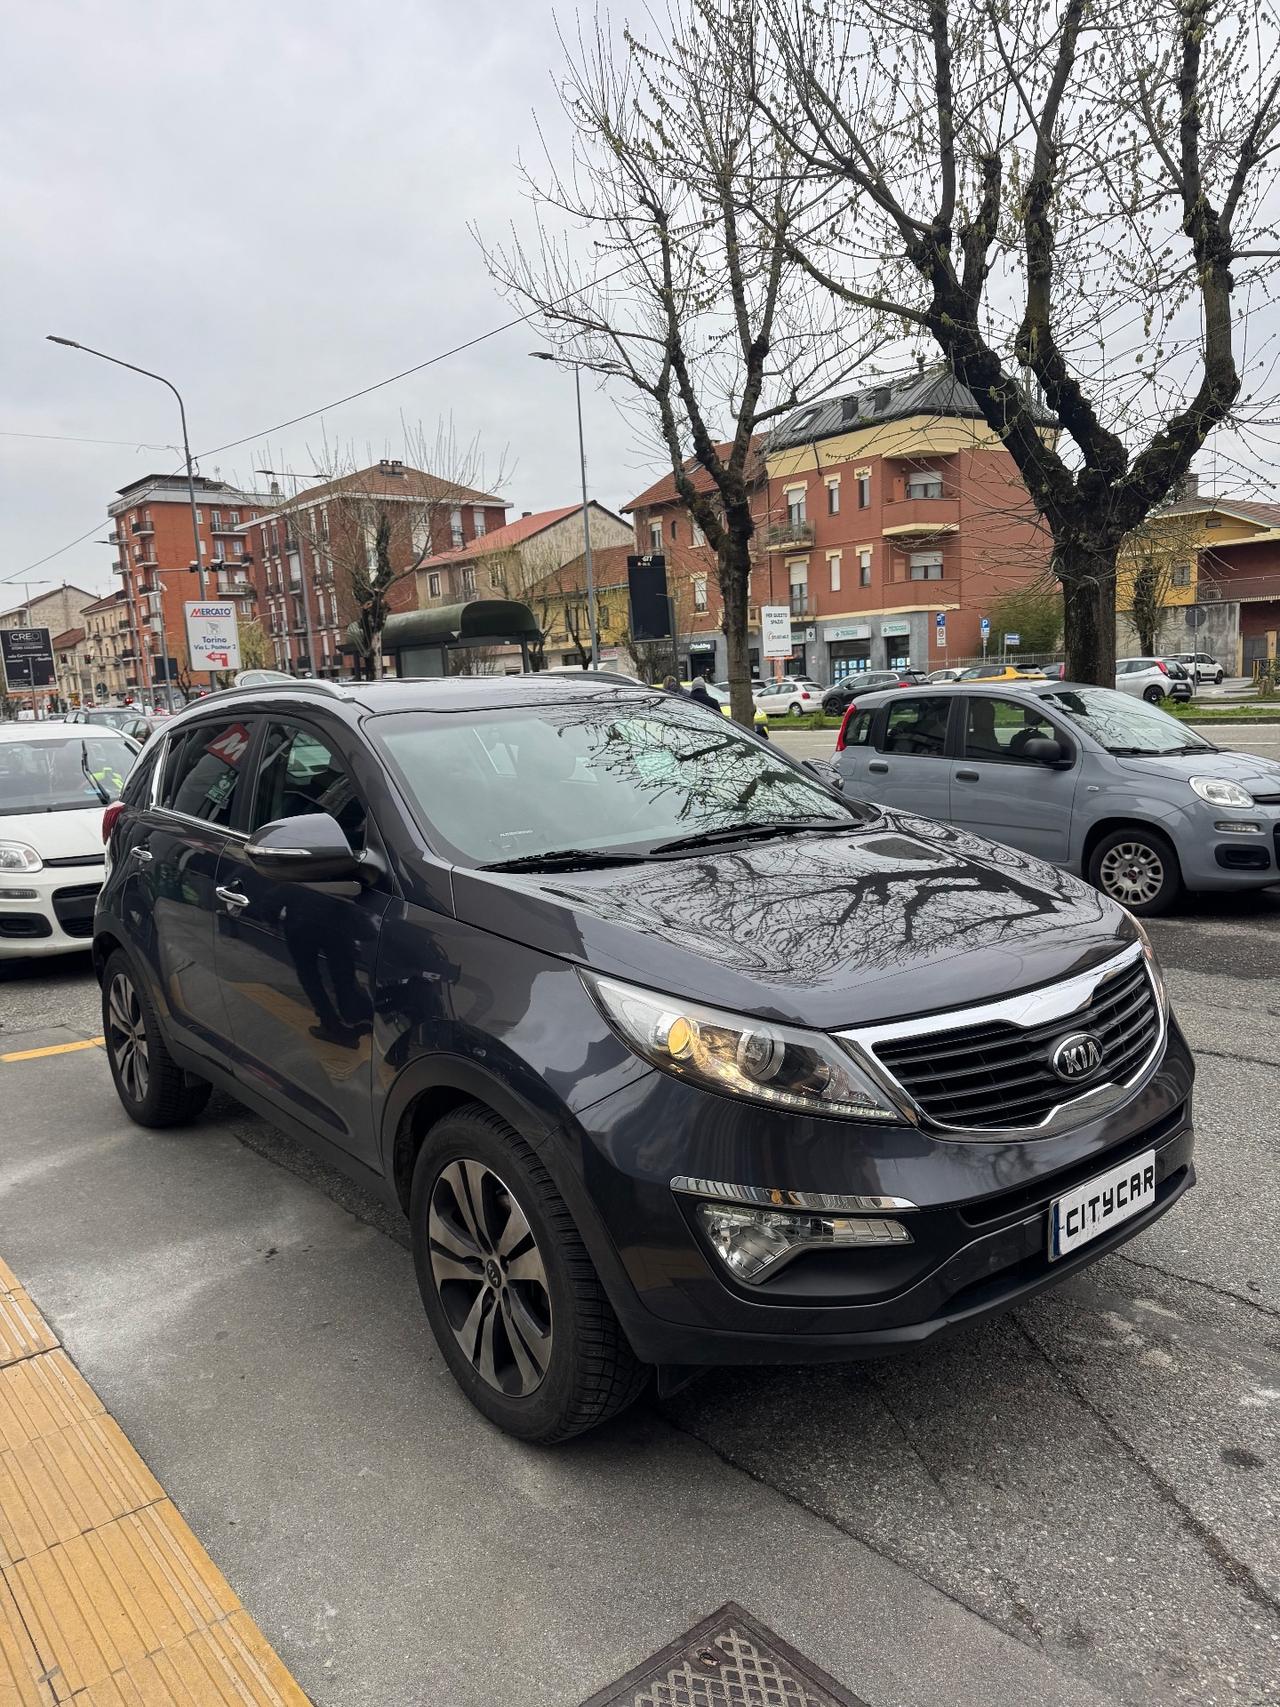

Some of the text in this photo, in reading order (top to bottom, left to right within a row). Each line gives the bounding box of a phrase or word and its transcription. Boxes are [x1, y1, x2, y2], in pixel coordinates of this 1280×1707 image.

[202, 635, 227, 643] Torino
[1063, 1041, 1100, 1074] KIA
[1066, 1165, 1154, 1238] CITYCAR
